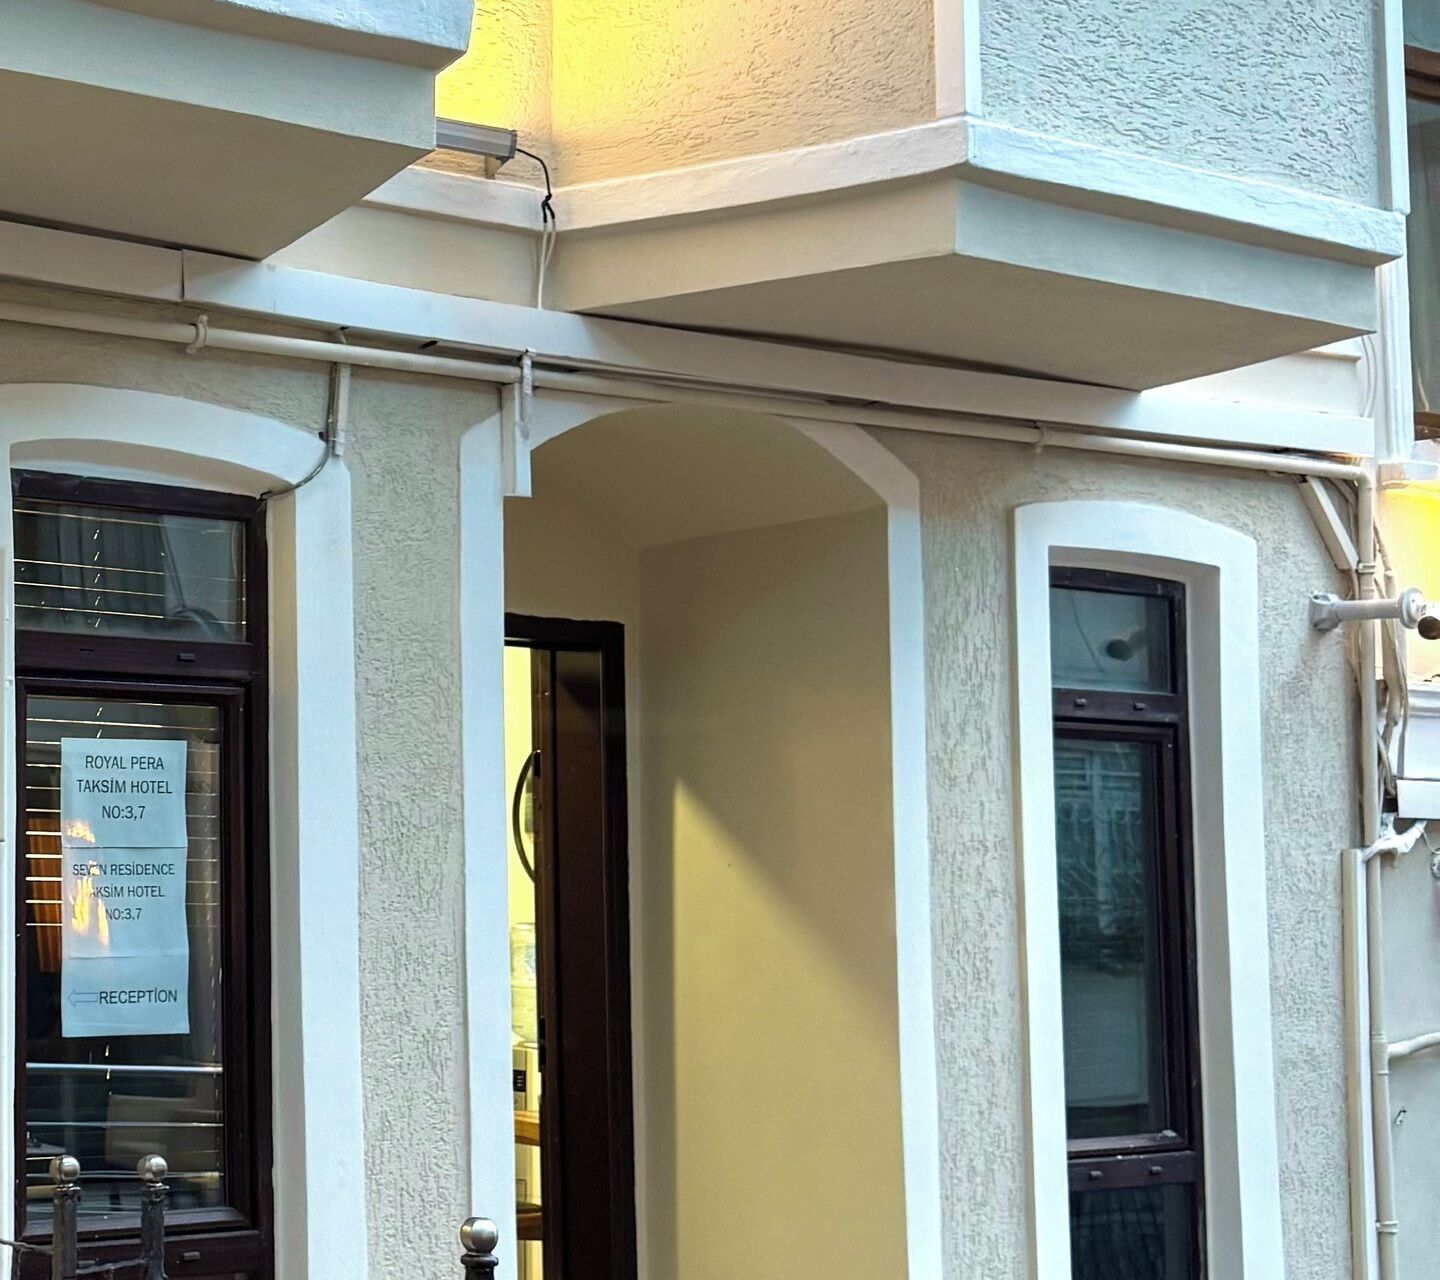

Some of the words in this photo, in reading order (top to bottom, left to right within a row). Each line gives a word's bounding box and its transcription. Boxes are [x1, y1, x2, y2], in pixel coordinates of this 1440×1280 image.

[85, 755, 127, 769] ROYAL
[131, 756, 164, 770] PERA
[77, 777, 126, 793] TAKSİM
[130, 781, 173, 794] HOTEL
[102, 805, 146, 821] NO:3,7
[110, 861, 175, 876] RESİDENCE
[85, 883, 124, 898] AKSİM
[127, 885, 165, 898] HOTEL
[98, 987, 178, 1004] RECEPTİON
